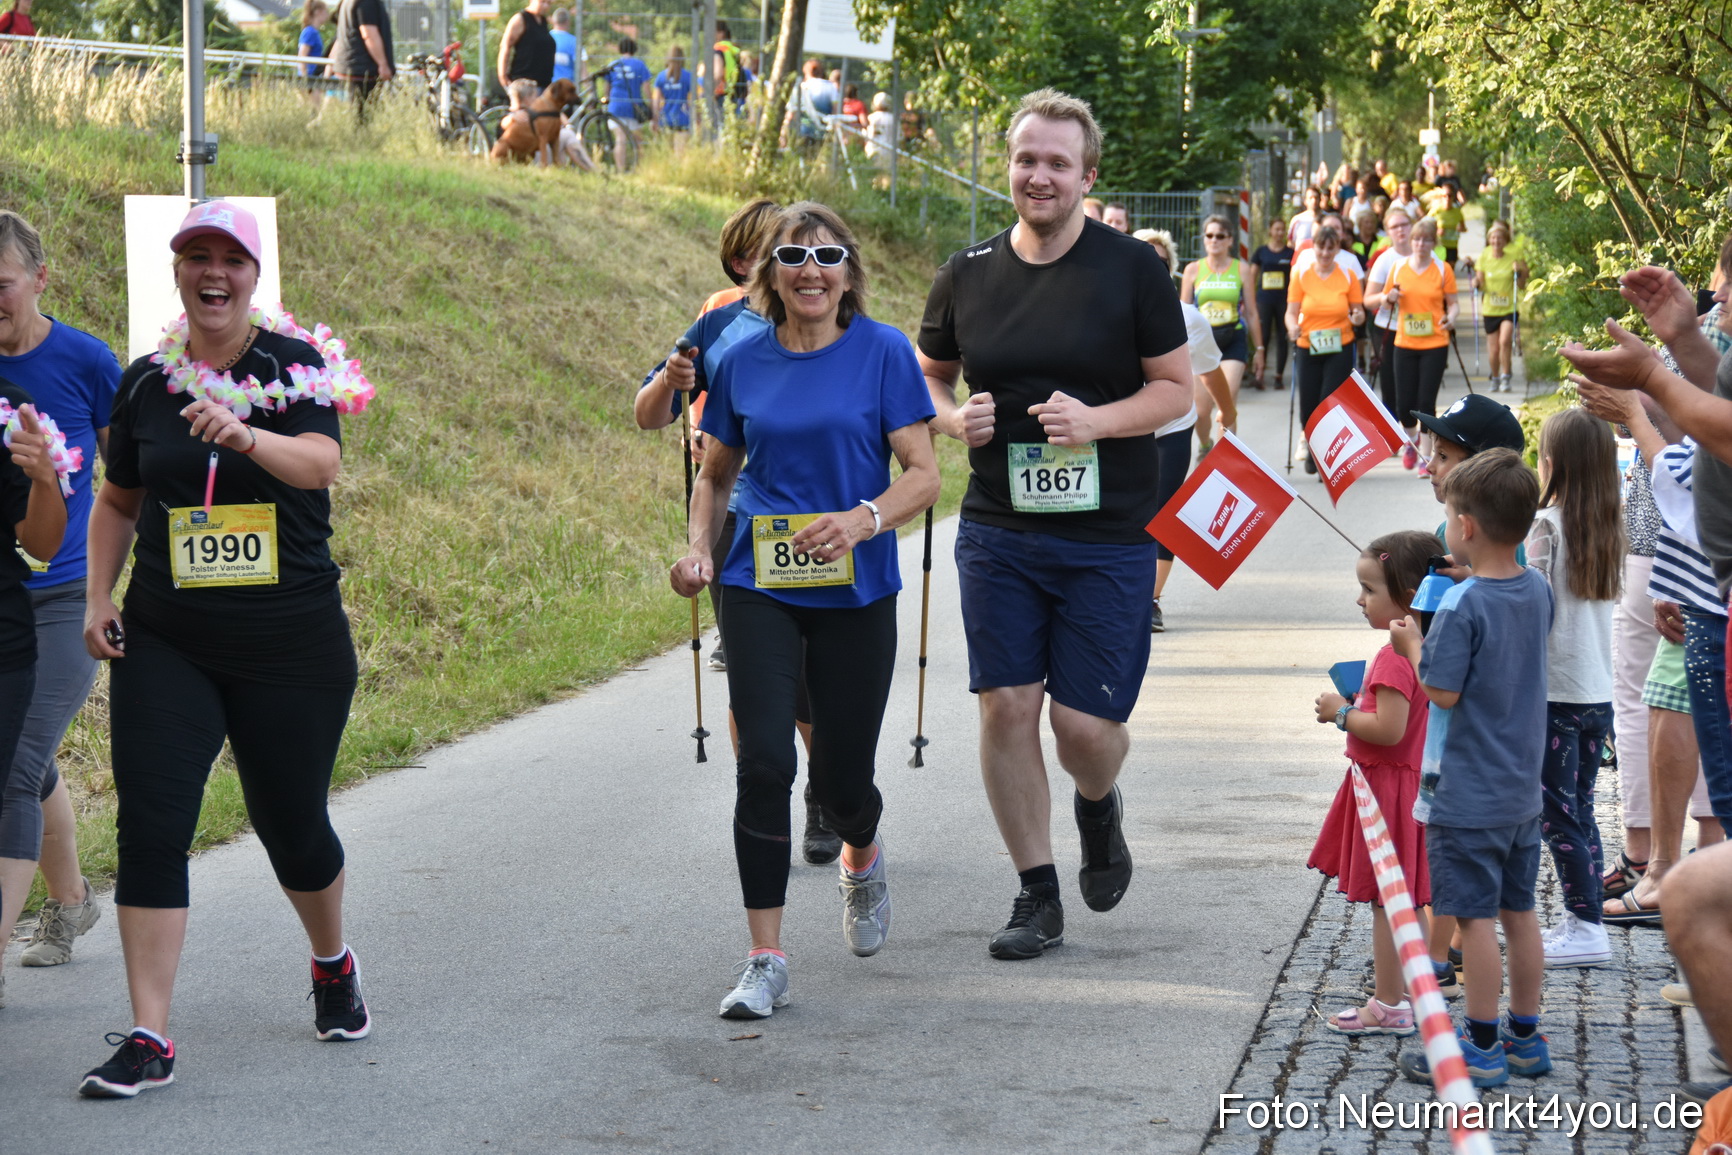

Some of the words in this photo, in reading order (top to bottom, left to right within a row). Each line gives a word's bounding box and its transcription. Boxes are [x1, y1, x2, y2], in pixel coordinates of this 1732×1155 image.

[1408, 320, 1426, 330] 106
[1317, 336, 1334, 347] 111
[1330, 467, 1347, 488] DEHN
[1346, 446, 1376, 471] protects.
[1020, 466, 1087, 493] 1867
[1022, 493, 1062, 501] Schuhmann
[1064, 492, 1088, 500] Philipp
[1217, 504, 1231, 528] DEHN
[1221, 537, 1242, 560] DEHN
[1239, 509, 1266, 541] protects.
[182, 532, 262, 565] 1990
[190, 565, 217, 574] Polster
[220, 564, 255, 572] Vanessa
[769, 567, 808, 575] Mitterhofer
[810, 566, 838, 574] Monika
